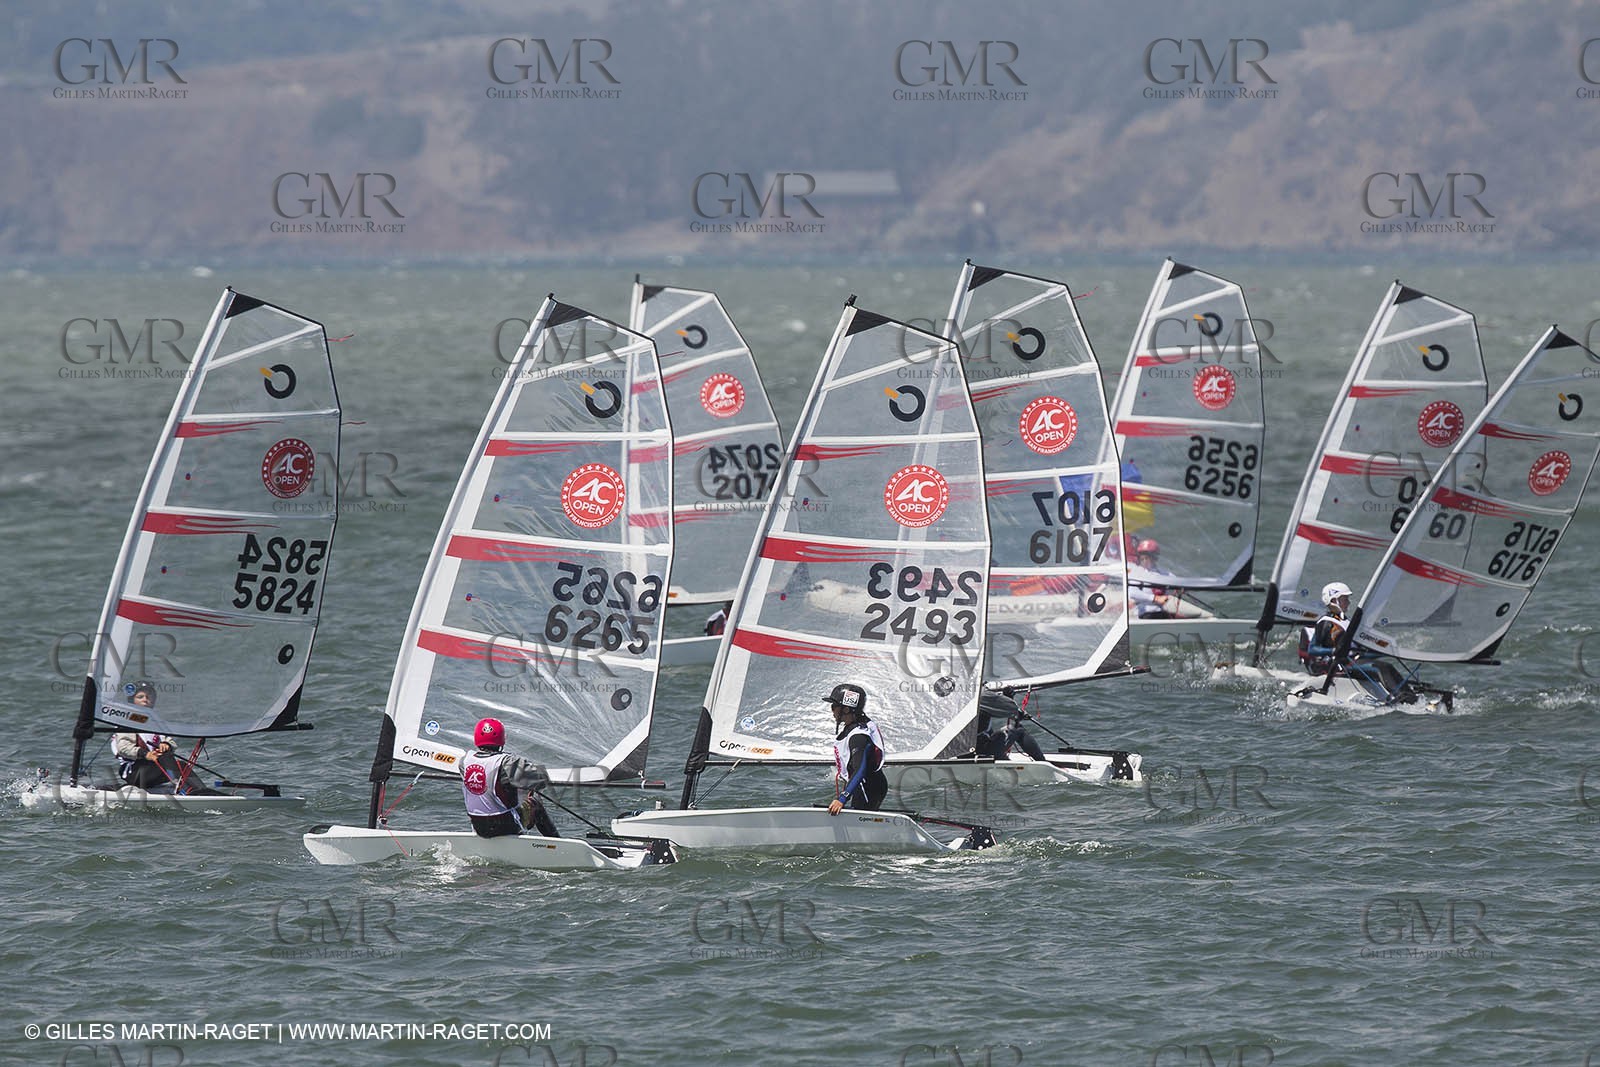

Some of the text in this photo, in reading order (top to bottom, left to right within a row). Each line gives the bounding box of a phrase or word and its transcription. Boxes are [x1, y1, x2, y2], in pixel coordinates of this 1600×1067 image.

[709, 382, 737, 403] AC
[1201, 376, 1226, 392] AC
[1030, 408, 1064, 434] AC
[1426, 412, 1456, 430] AC
[1034, 430, 1064, 443] OPEN
[271, 452, 305, 474] AC
[1537, 461, 1564, 479] AC
[273, 476, 300, 485] OPEN
[571, 477, 614, 505] AC
[895, 479, 936, 503] AC
[1185, 464, 1254, 499] 6256
[562, 502, 572, 515] SAN
[570, 513, 602, 528] FRANCISCO
[572, 499, 605, 516] OPEN
[898, 503, 930, 514] OPEN
[1390, 507, 1466, 540] 660
[1030, 527, 1113, 564] 6107
[1488, 550, 1543, 581] 6176
[232, 572, 316, 614] 5824
[545, 604, 655, 654] 6265
[860, 603, 976, 645] 2493
[467, 771, 484, 784] AC
